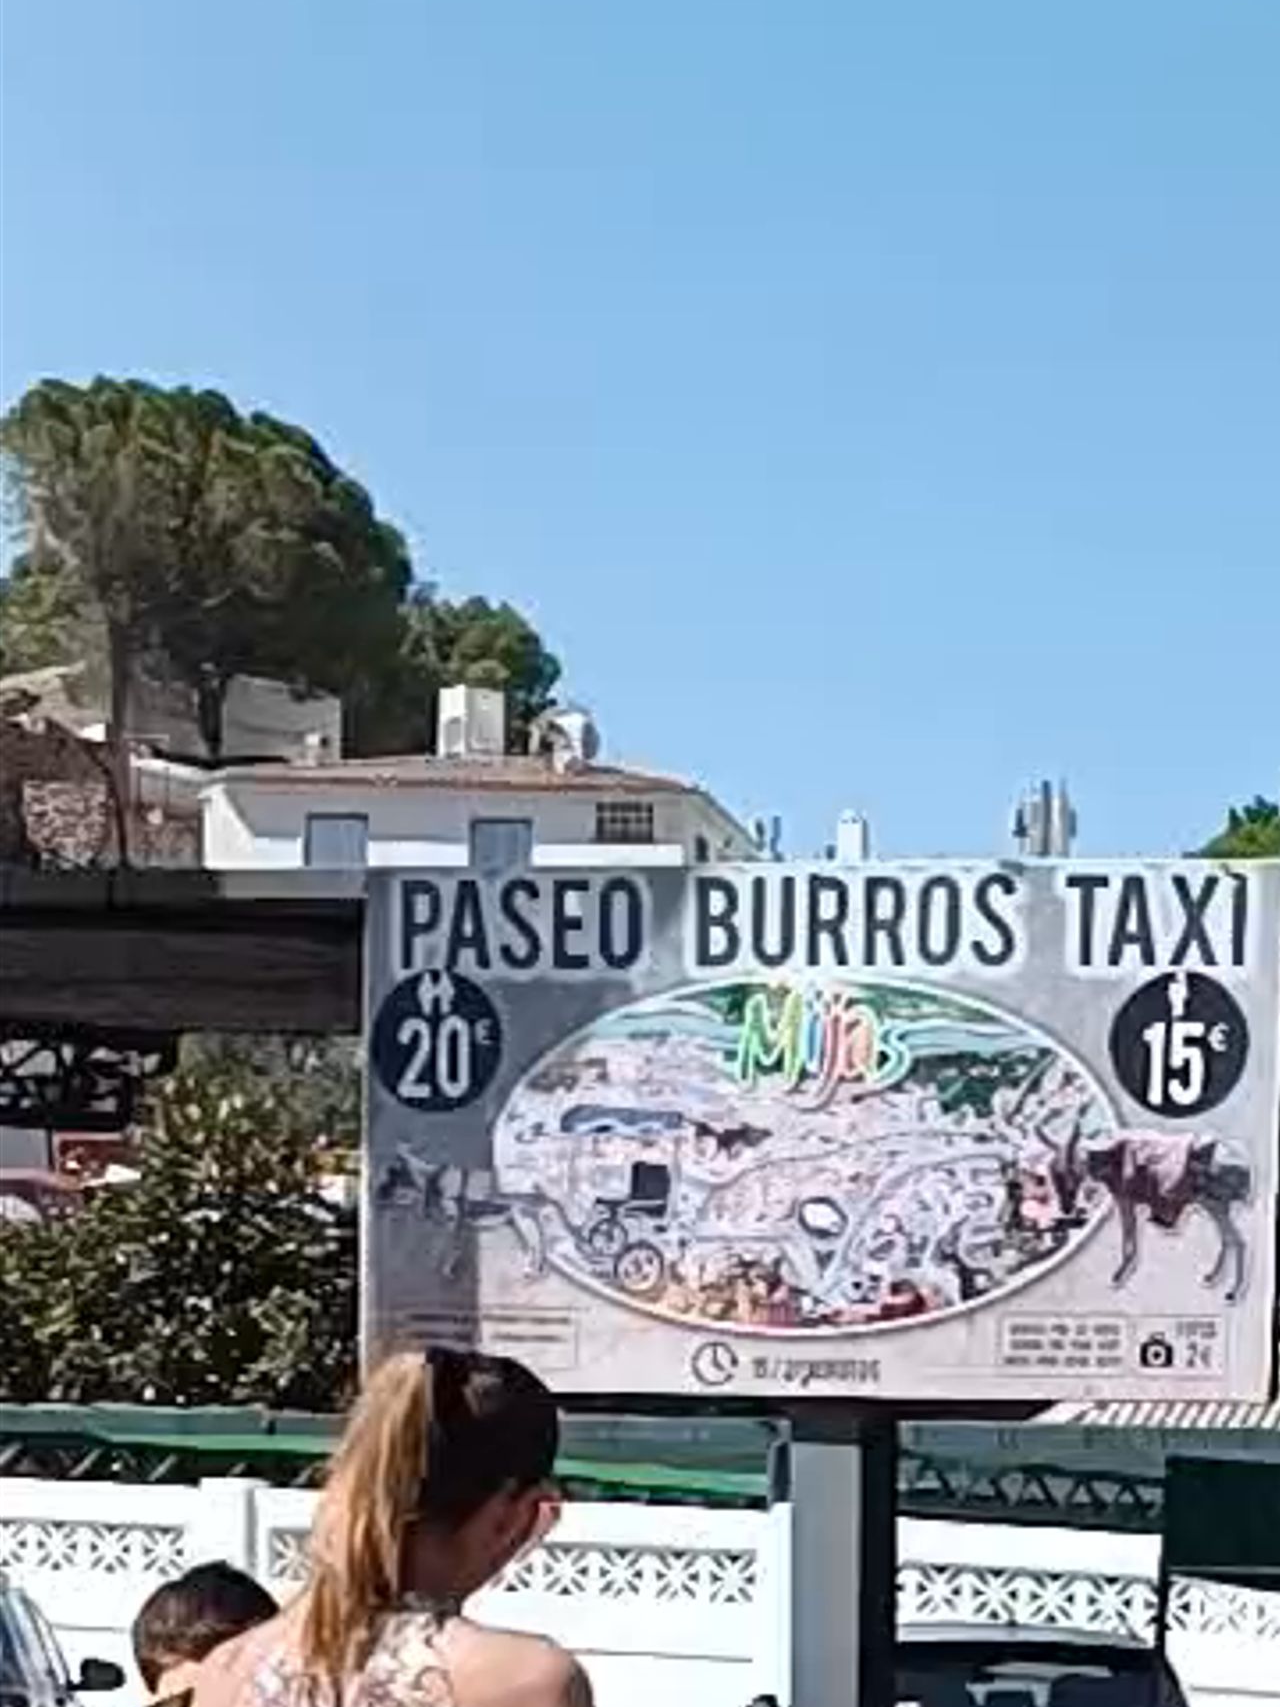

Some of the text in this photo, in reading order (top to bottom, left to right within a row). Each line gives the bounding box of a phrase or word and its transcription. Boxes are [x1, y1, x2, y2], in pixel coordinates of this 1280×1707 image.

[400, 869, 1248, 971] PASEO BURROS TAXI
[737, 987, 911, 1113] Mijas
